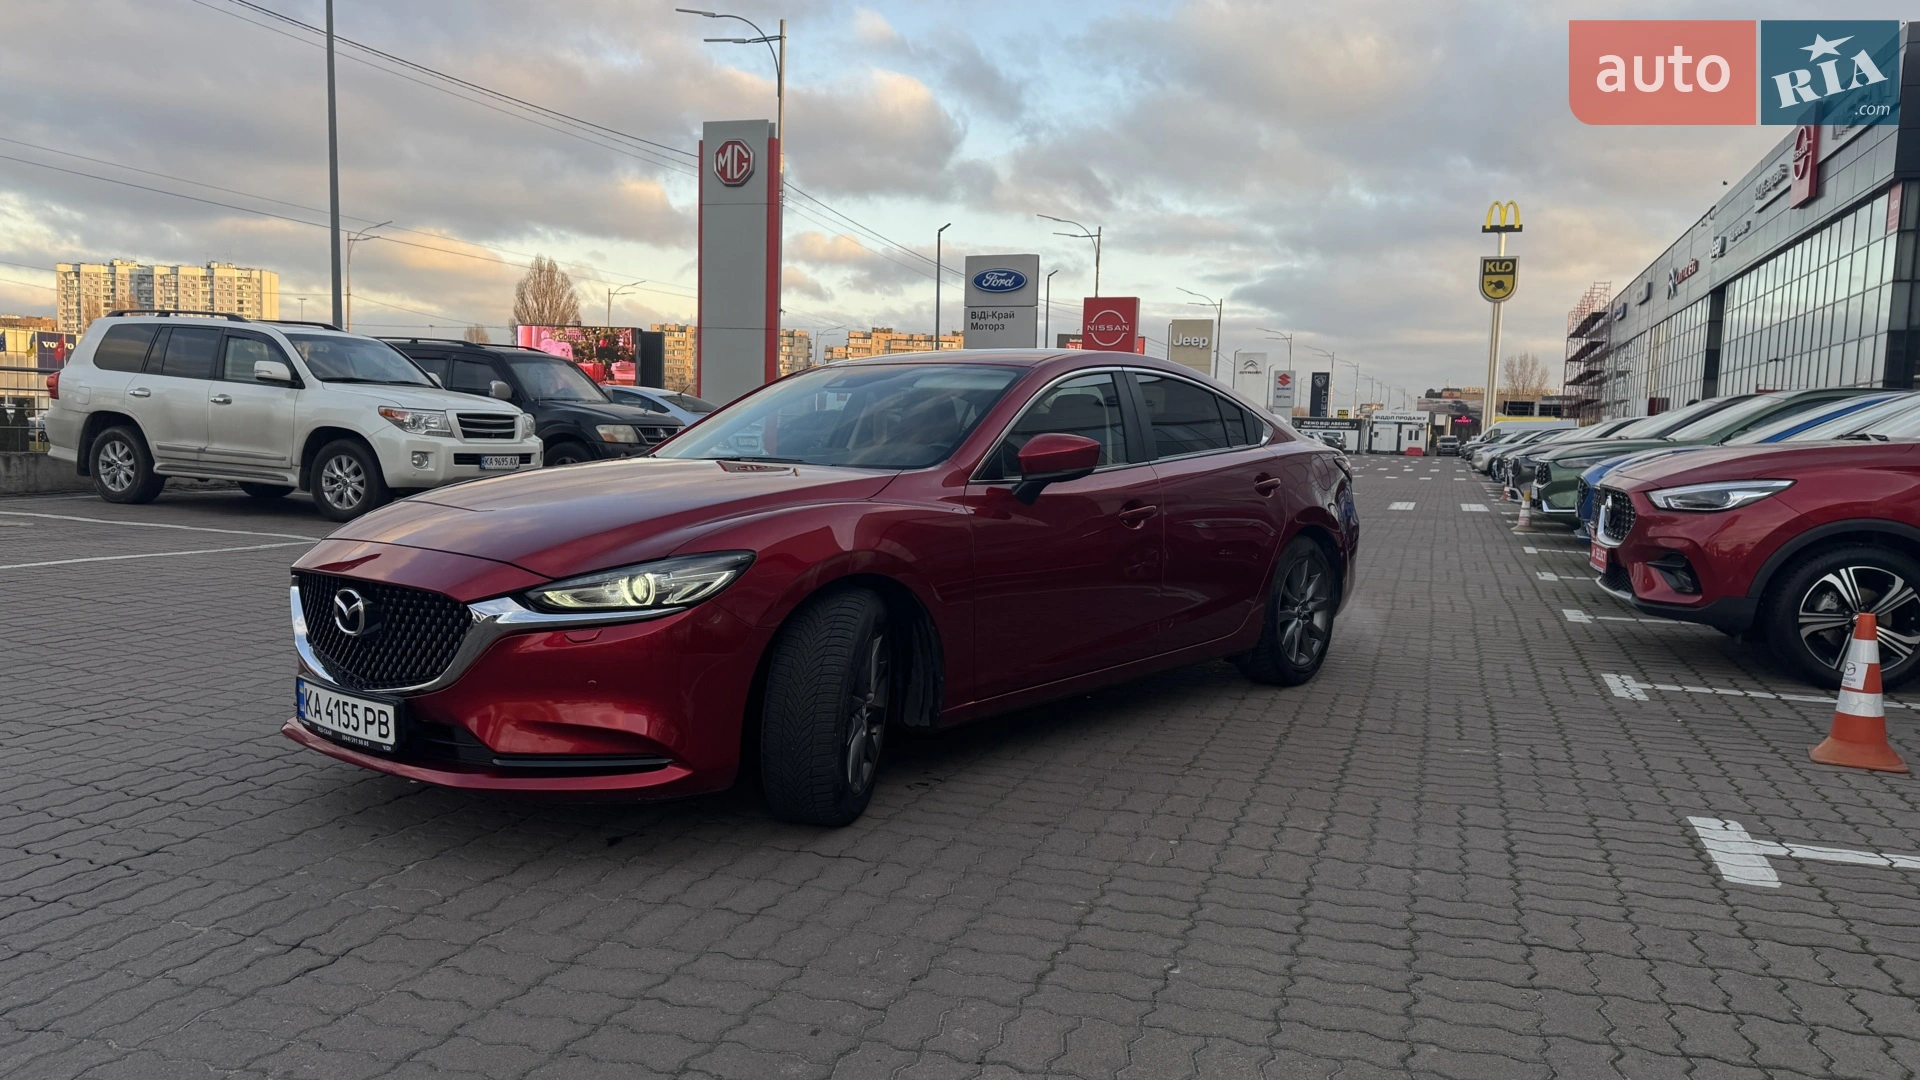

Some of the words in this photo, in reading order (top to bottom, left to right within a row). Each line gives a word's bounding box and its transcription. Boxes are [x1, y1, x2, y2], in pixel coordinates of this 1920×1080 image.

[717, 144, 749, 179] MG
[1485, 261, 1514, 273] KLO
[982, 271, 1016, 287] Ford
[970, 310, 1015, 321] ВіДі-Край
[970, 322, 1005, 332] Моторз
[1087, 324, 1130, 332] NISSAN
[42, 341, 75, 350] VOO
[1173, 332, 1209, 349] Jeep
[494, 457, 508, 466] 9695
[304, 687, 323, 721] KA
[325, 696, 360, 732] 4155
[363, 706, 390, 739] PB
